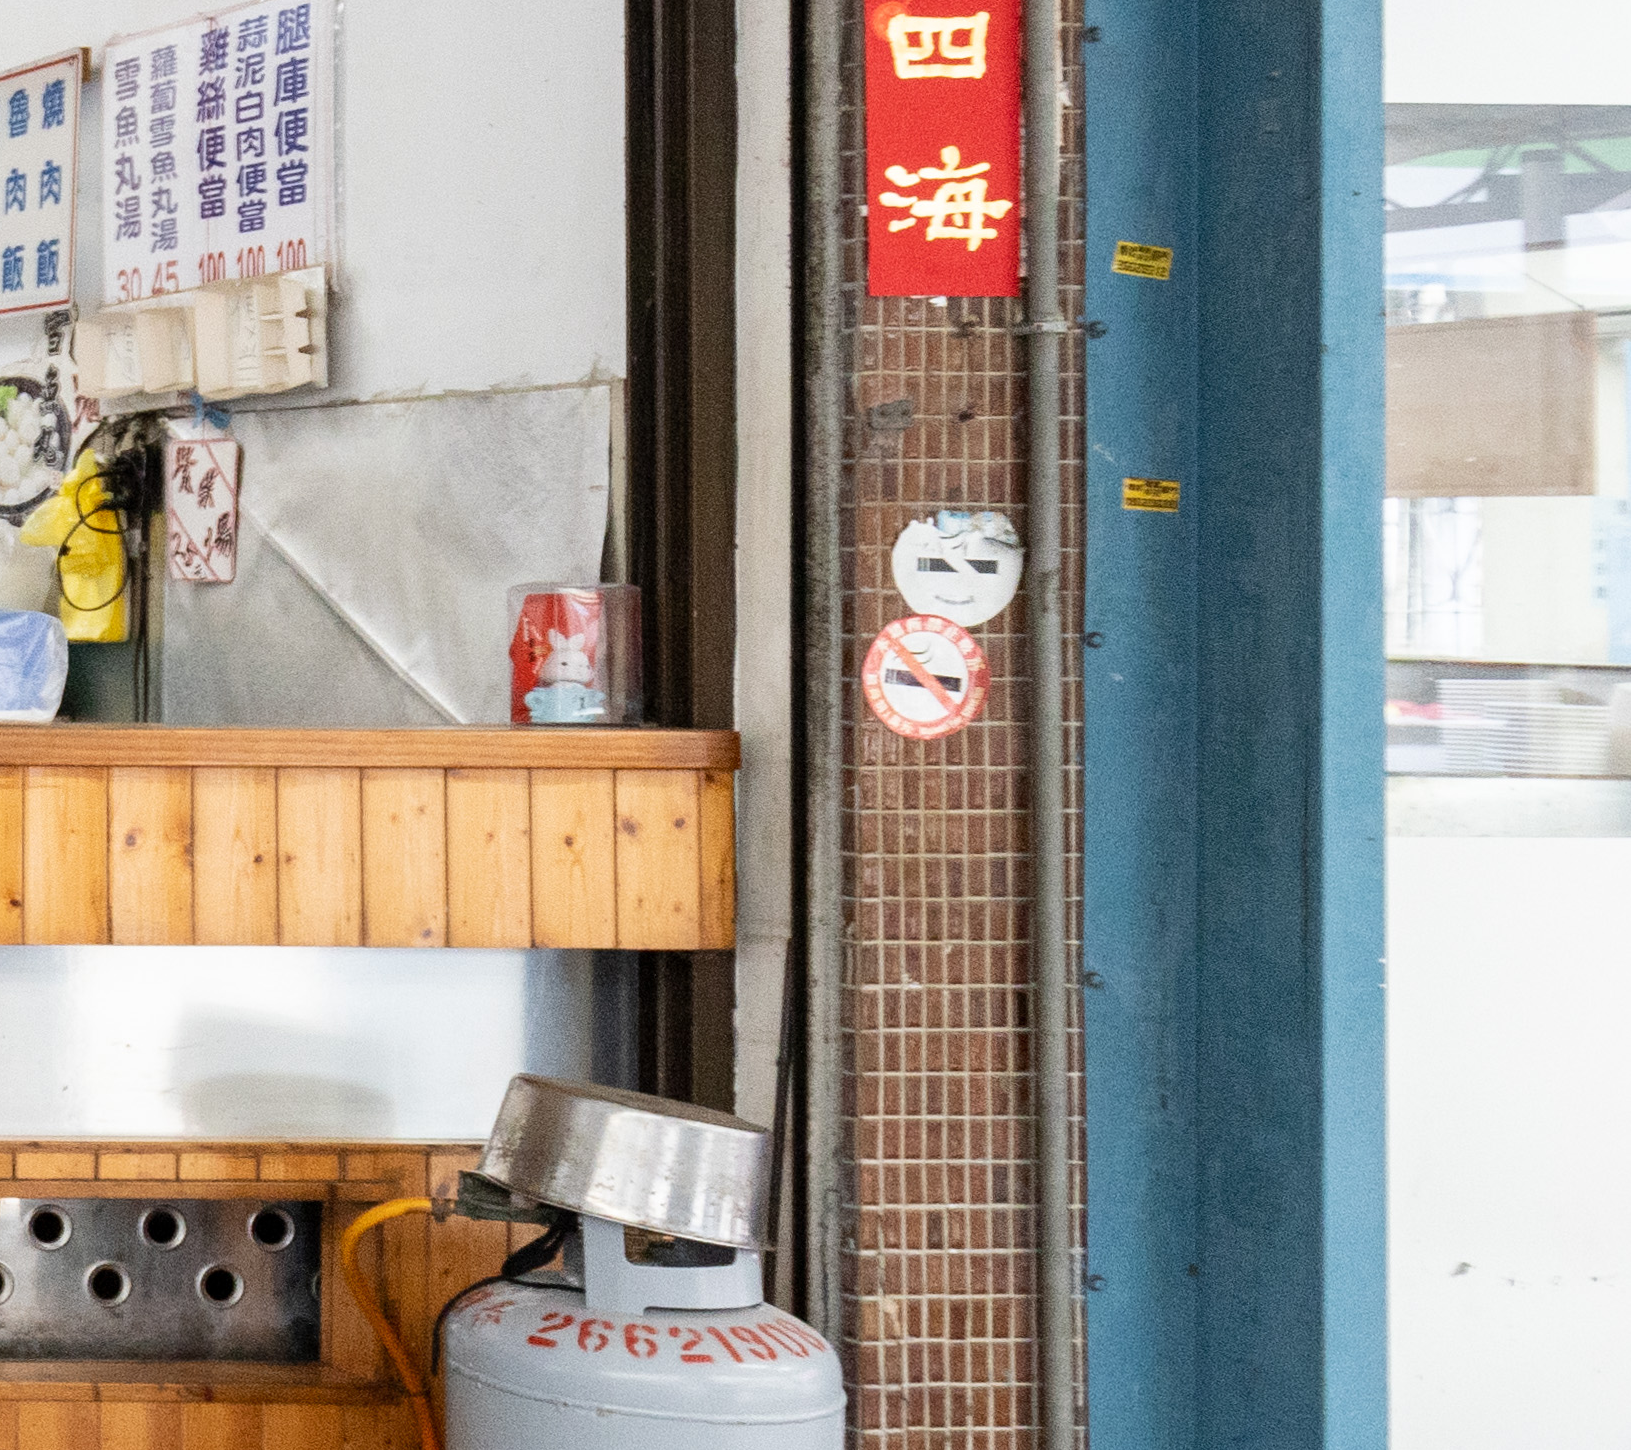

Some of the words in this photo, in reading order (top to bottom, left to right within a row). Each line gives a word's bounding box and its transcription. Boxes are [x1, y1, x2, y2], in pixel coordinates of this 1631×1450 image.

[274, 2, 312, 207] 腿庫便當
[234, 14, 270, 235] 蒜泥白肉便當
[198, 250, 227, 284] 100
[237, 244, 267, 280] 100
[276, 237, 307, 272] 100
[117, 266, 143, 302] 30
[151, 259, 180, 297] 45
